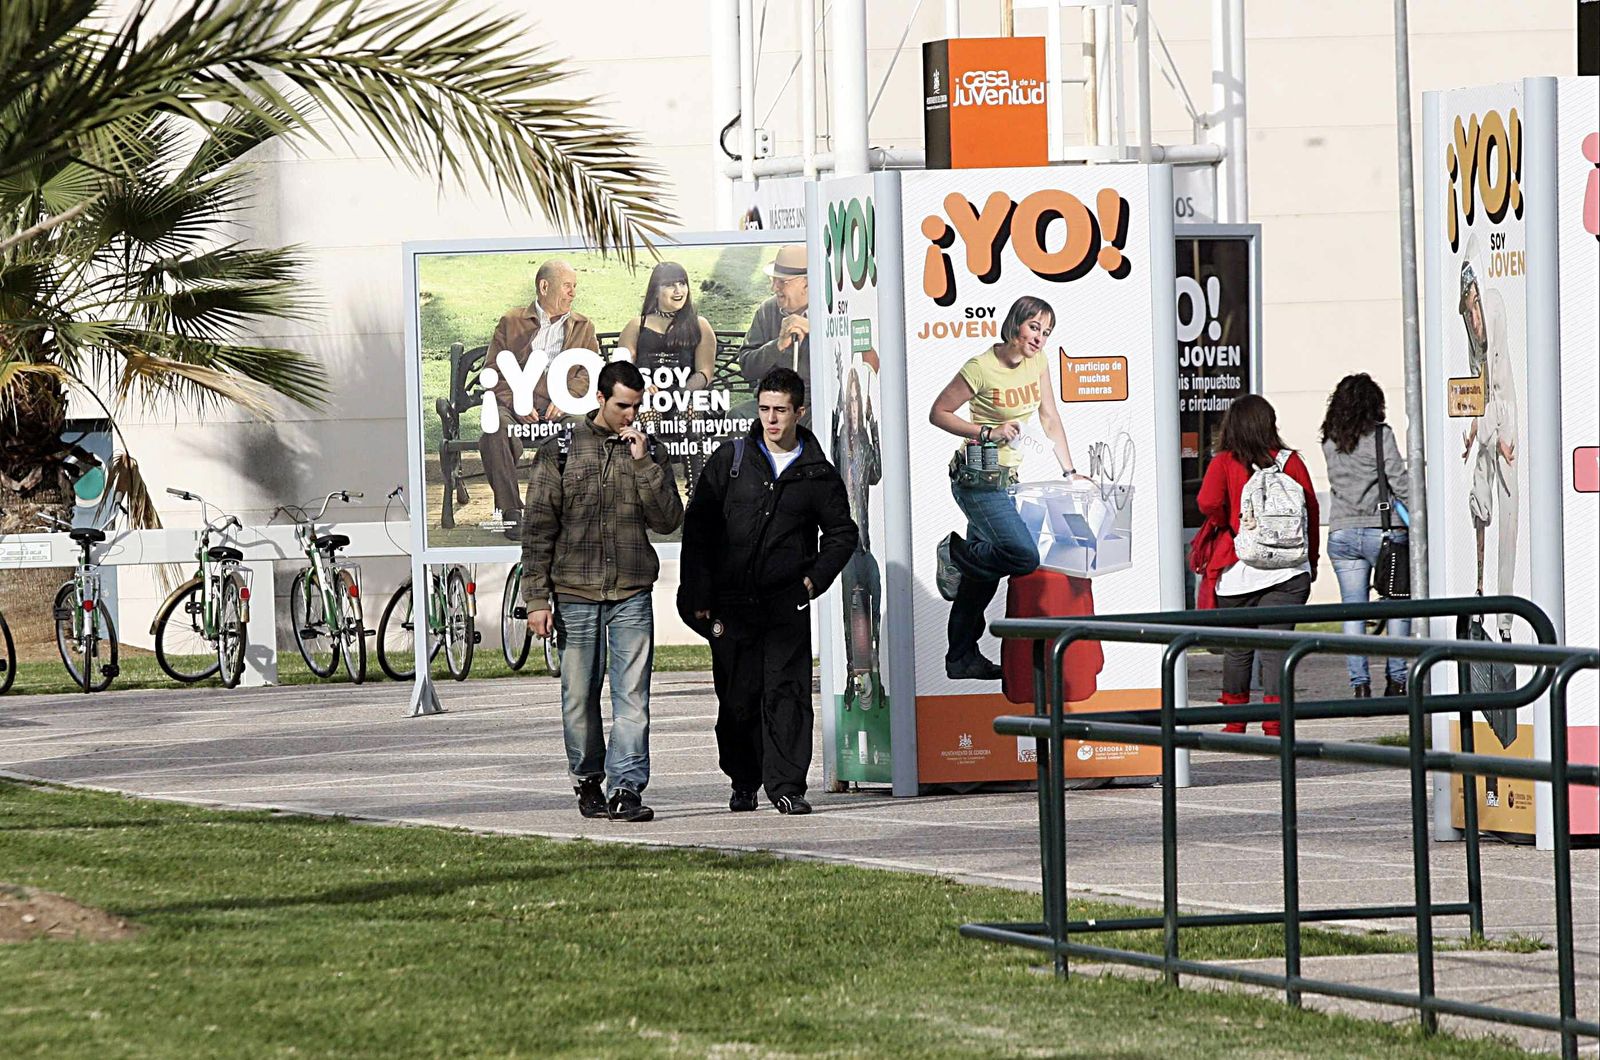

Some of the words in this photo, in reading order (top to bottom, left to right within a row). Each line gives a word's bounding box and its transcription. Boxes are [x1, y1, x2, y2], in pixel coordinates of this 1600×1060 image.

[963, 70, 1010, 88] casa
[953, 78, 1044, 107] juventud
[1447, 108, 1523, 253] ¡YO!
[921, 188, 1130, 305] ¡YO!
[1490, 232, 1506, 251] SOY
[824, 196, 877, 313] ¡YO!
[1488, 251, 1526, 278] JOVEN
[838, 300, 848, 315] SOY
[964, 306, 996, 319] SOY
[826, 316, 849, 338] JOVEN
[917, 320, 998, 340] JOVEN
[1067, 362, 1073, 371] Y
[1075, 362, 1110, 373] participo
[1112, 361, 1122, 370] de
[1179, 345, 1241, 368] JOVEN
[1079, 374, 1111, 384] muchas
[1179, 373, 1190, 390] is
[1192, 373, 1241, 394] impuestos
[479, 347, 633, 434] ¡YO
[639, 389, 731, 413] JOVEN
[992, 382, 1041, 409] LOVE
[1078, 386, 1113, 395] maneras
[660, 416, 688, 434] mis
[692, 417, 756, 437] mayores
